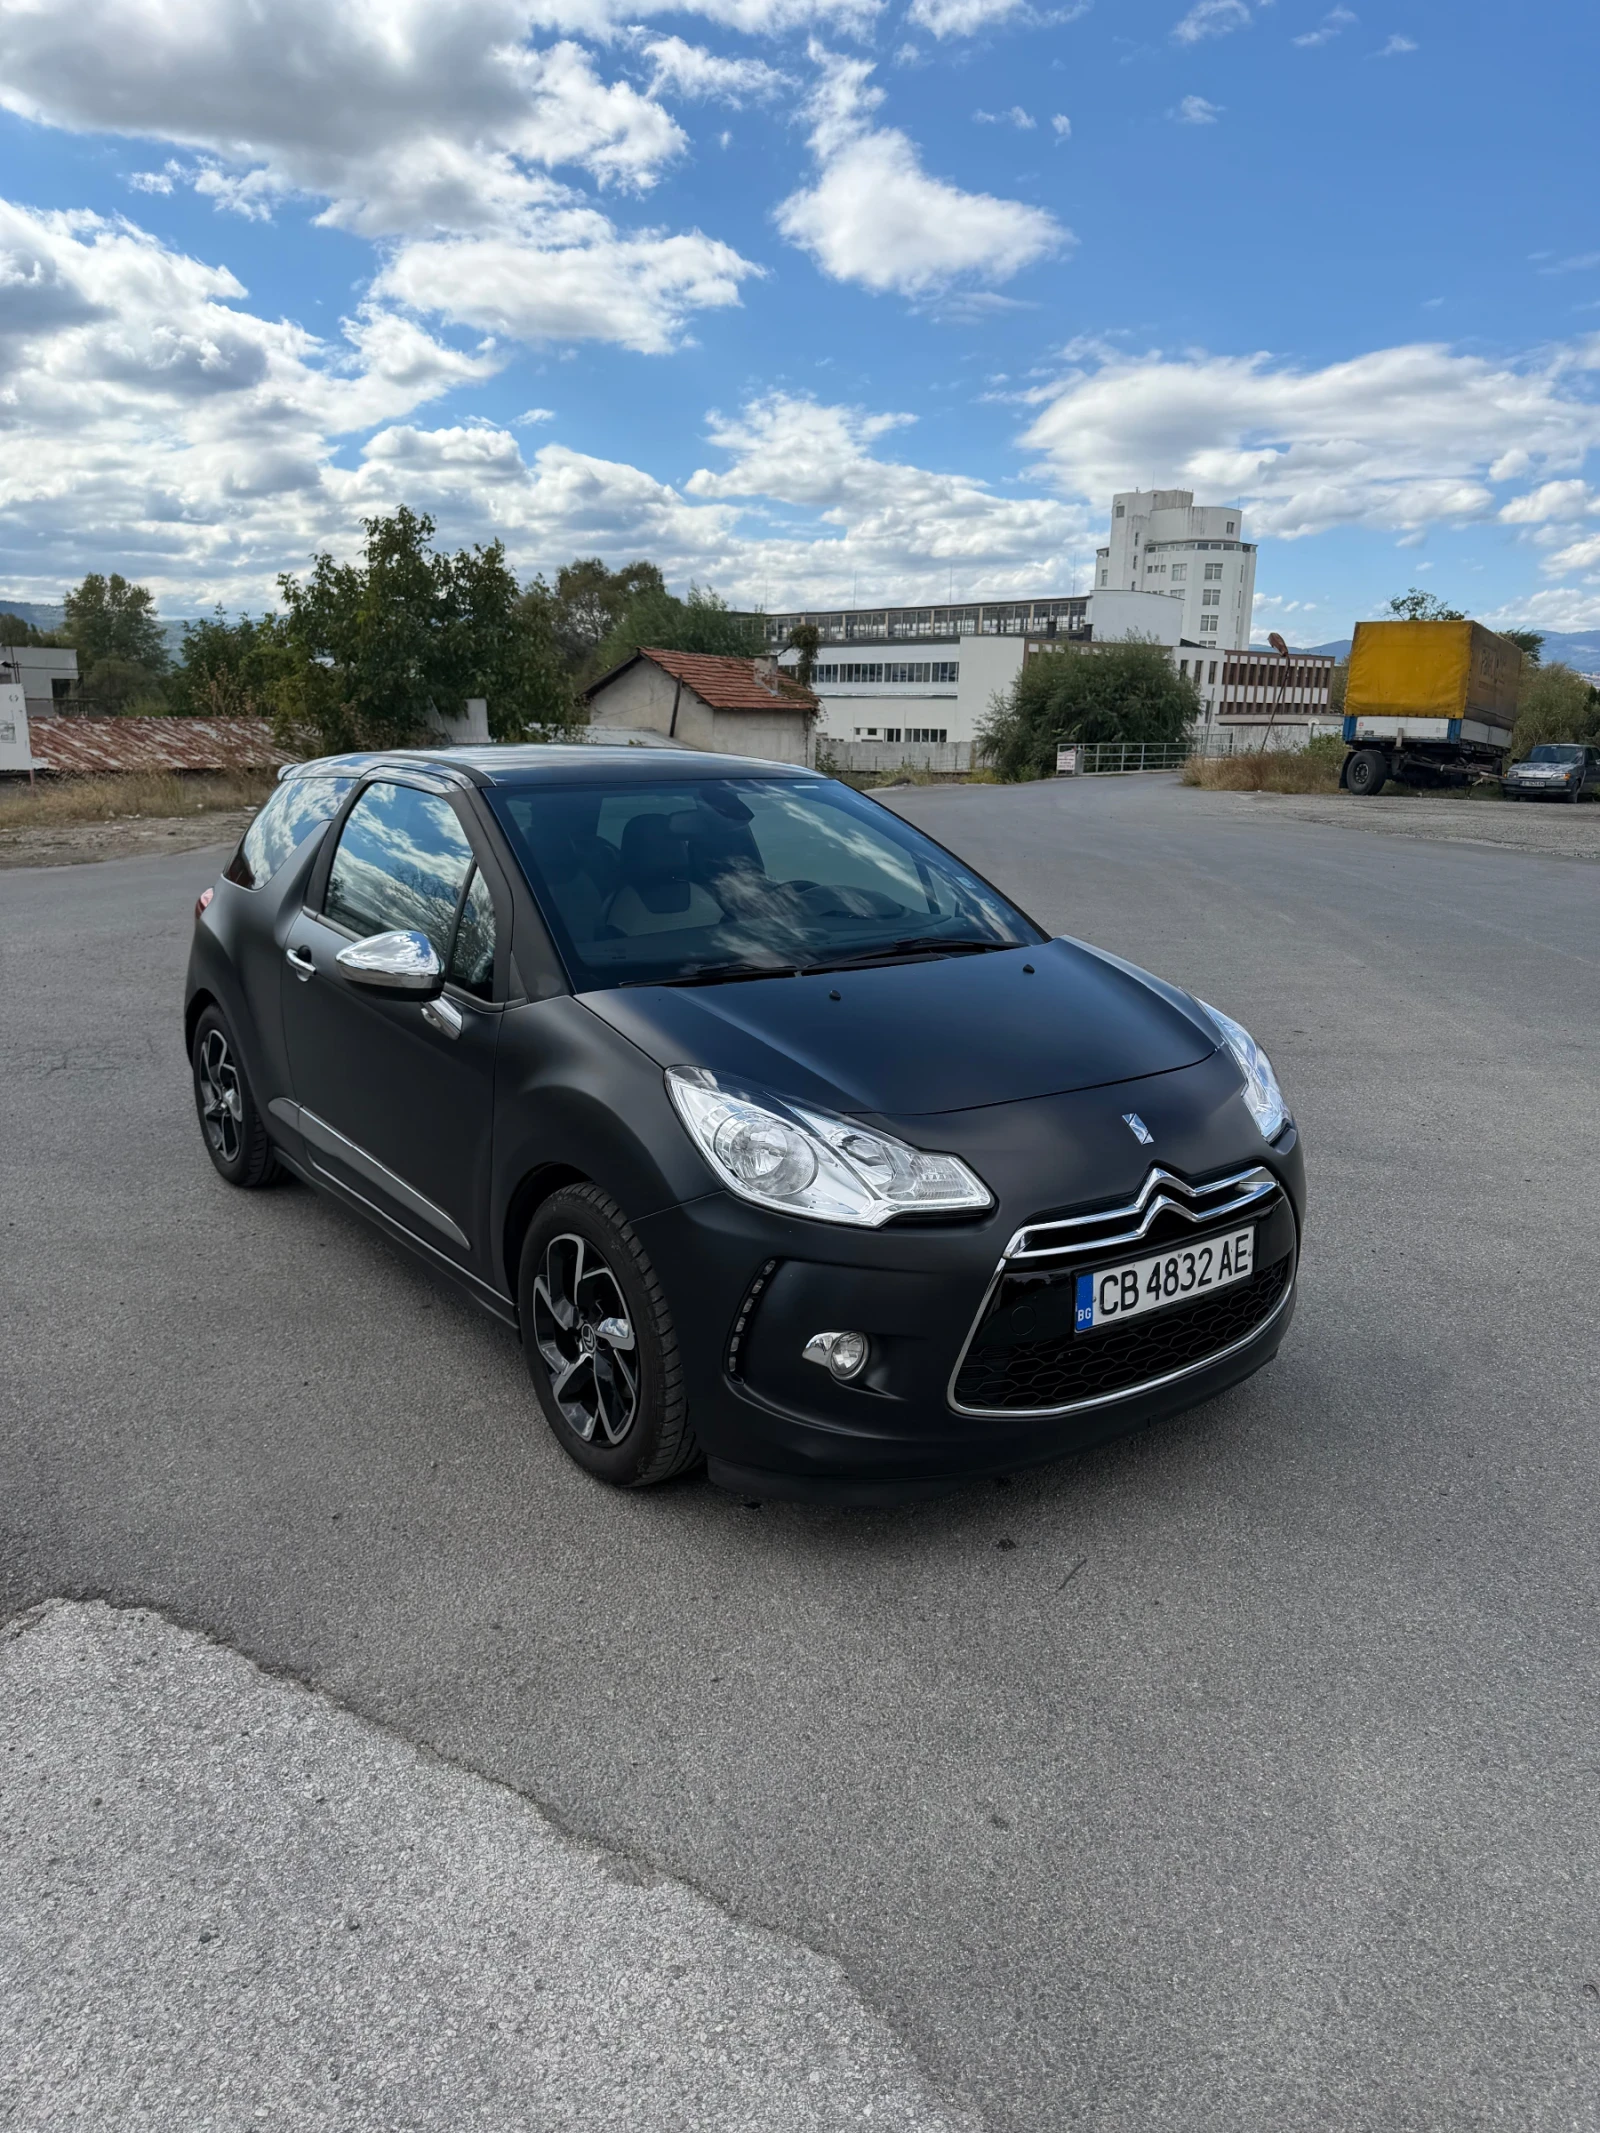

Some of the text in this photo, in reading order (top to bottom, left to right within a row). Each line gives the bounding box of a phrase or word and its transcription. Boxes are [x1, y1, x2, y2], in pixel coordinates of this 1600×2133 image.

[1100, 1234, 1250, 1315] CB 4832 AE
[1077, 1307, 1092, 1322] BG
